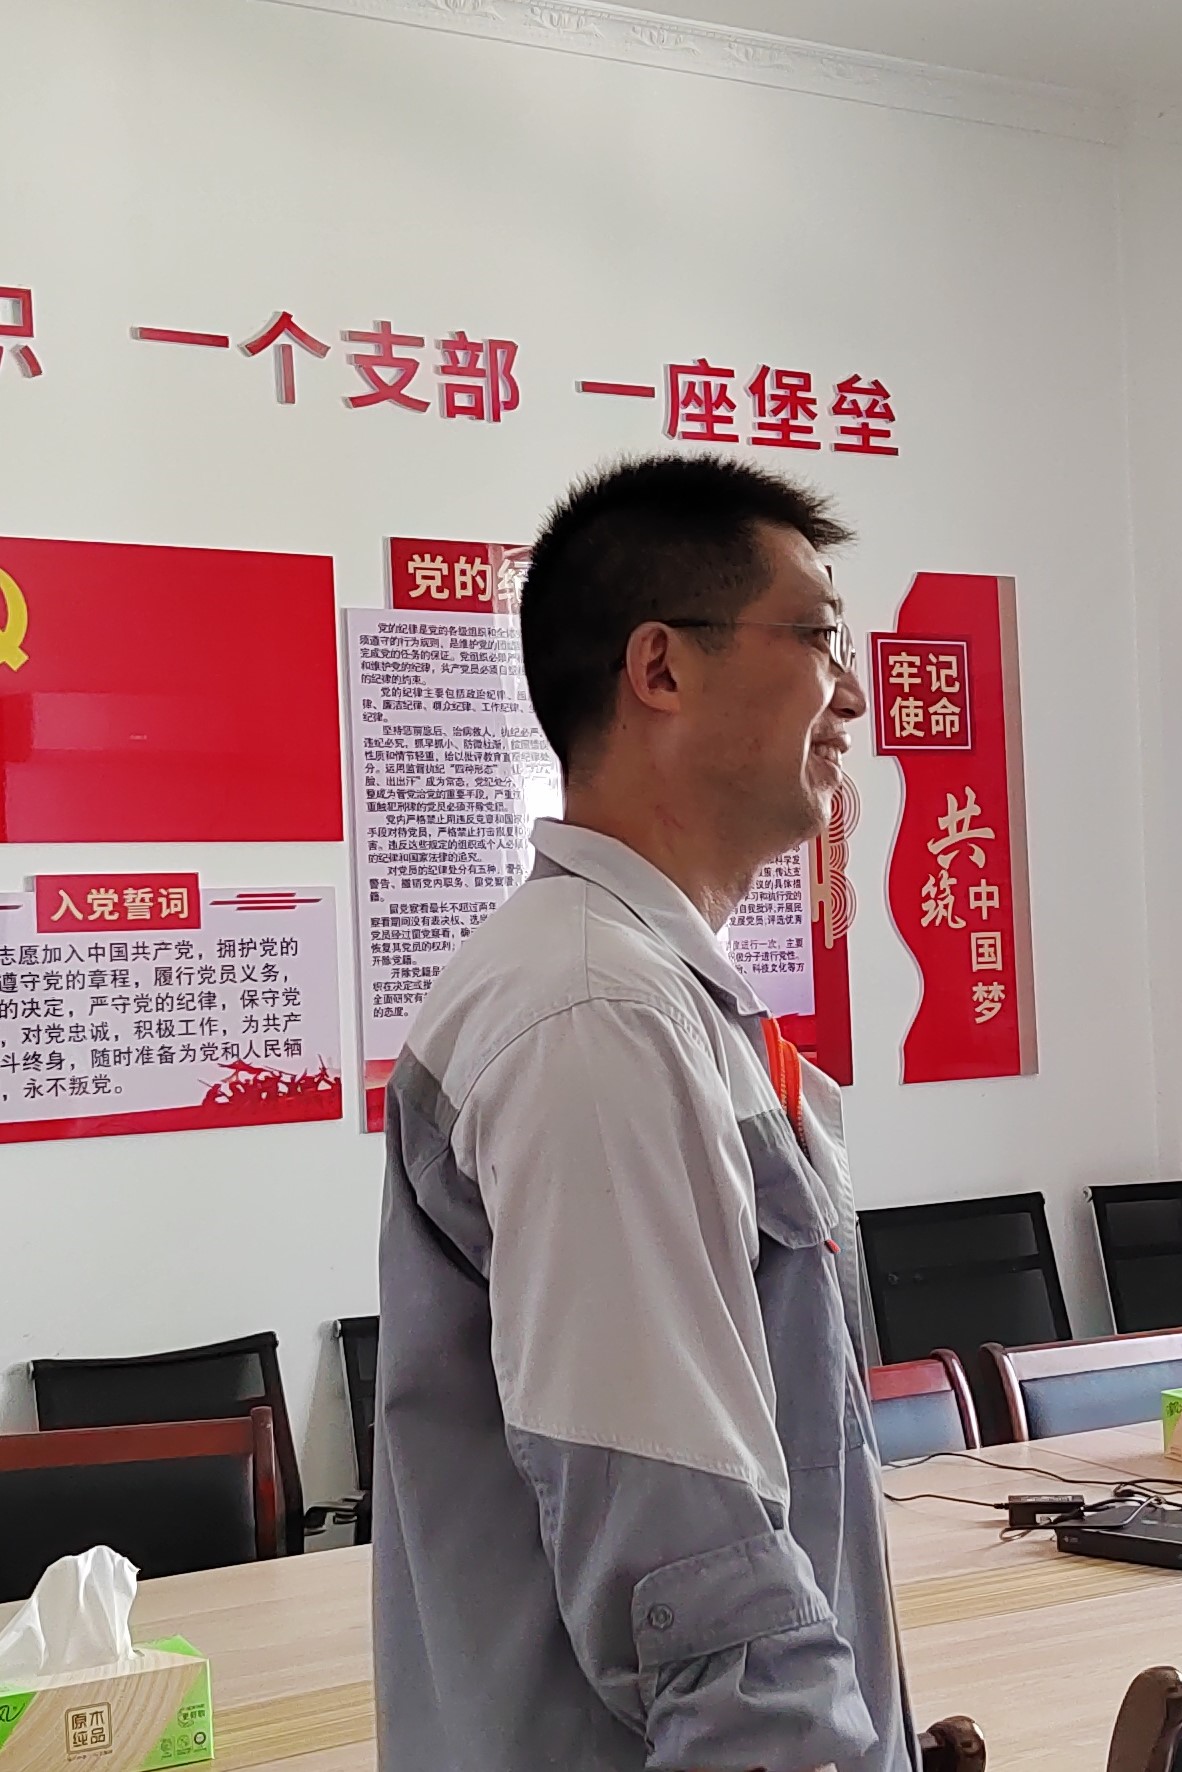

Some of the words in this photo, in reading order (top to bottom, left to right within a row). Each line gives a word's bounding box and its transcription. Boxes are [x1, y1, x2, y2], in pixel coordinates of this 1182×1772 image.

[131, 311, 520, 422] 一个支部
[577, 357, 901, 457] 一座堡垒
[888, 652, 960, 693] 牢记
[889, 697, 962, 738] 使命
[920, 786, 997, 929] 共筑
[50, 887, 189, 921] 入党誓词
[0, 936, 299, 966] 志愿加入中国共产党，拥护党的
[968, 879, 1006, 1024] 中国梦
[0, 963, 290, 994] 遵守党的章程，履行党员义务，
[0, 986, 301, 1020] 的决定，严守党的纪律，保守党
[0, 1038, 303, 1075] 斗终身，随时准备为党和人民牺
[71, 1709, 105, 1730] 原木
[72, 1726, 107, 1748] 纯品
